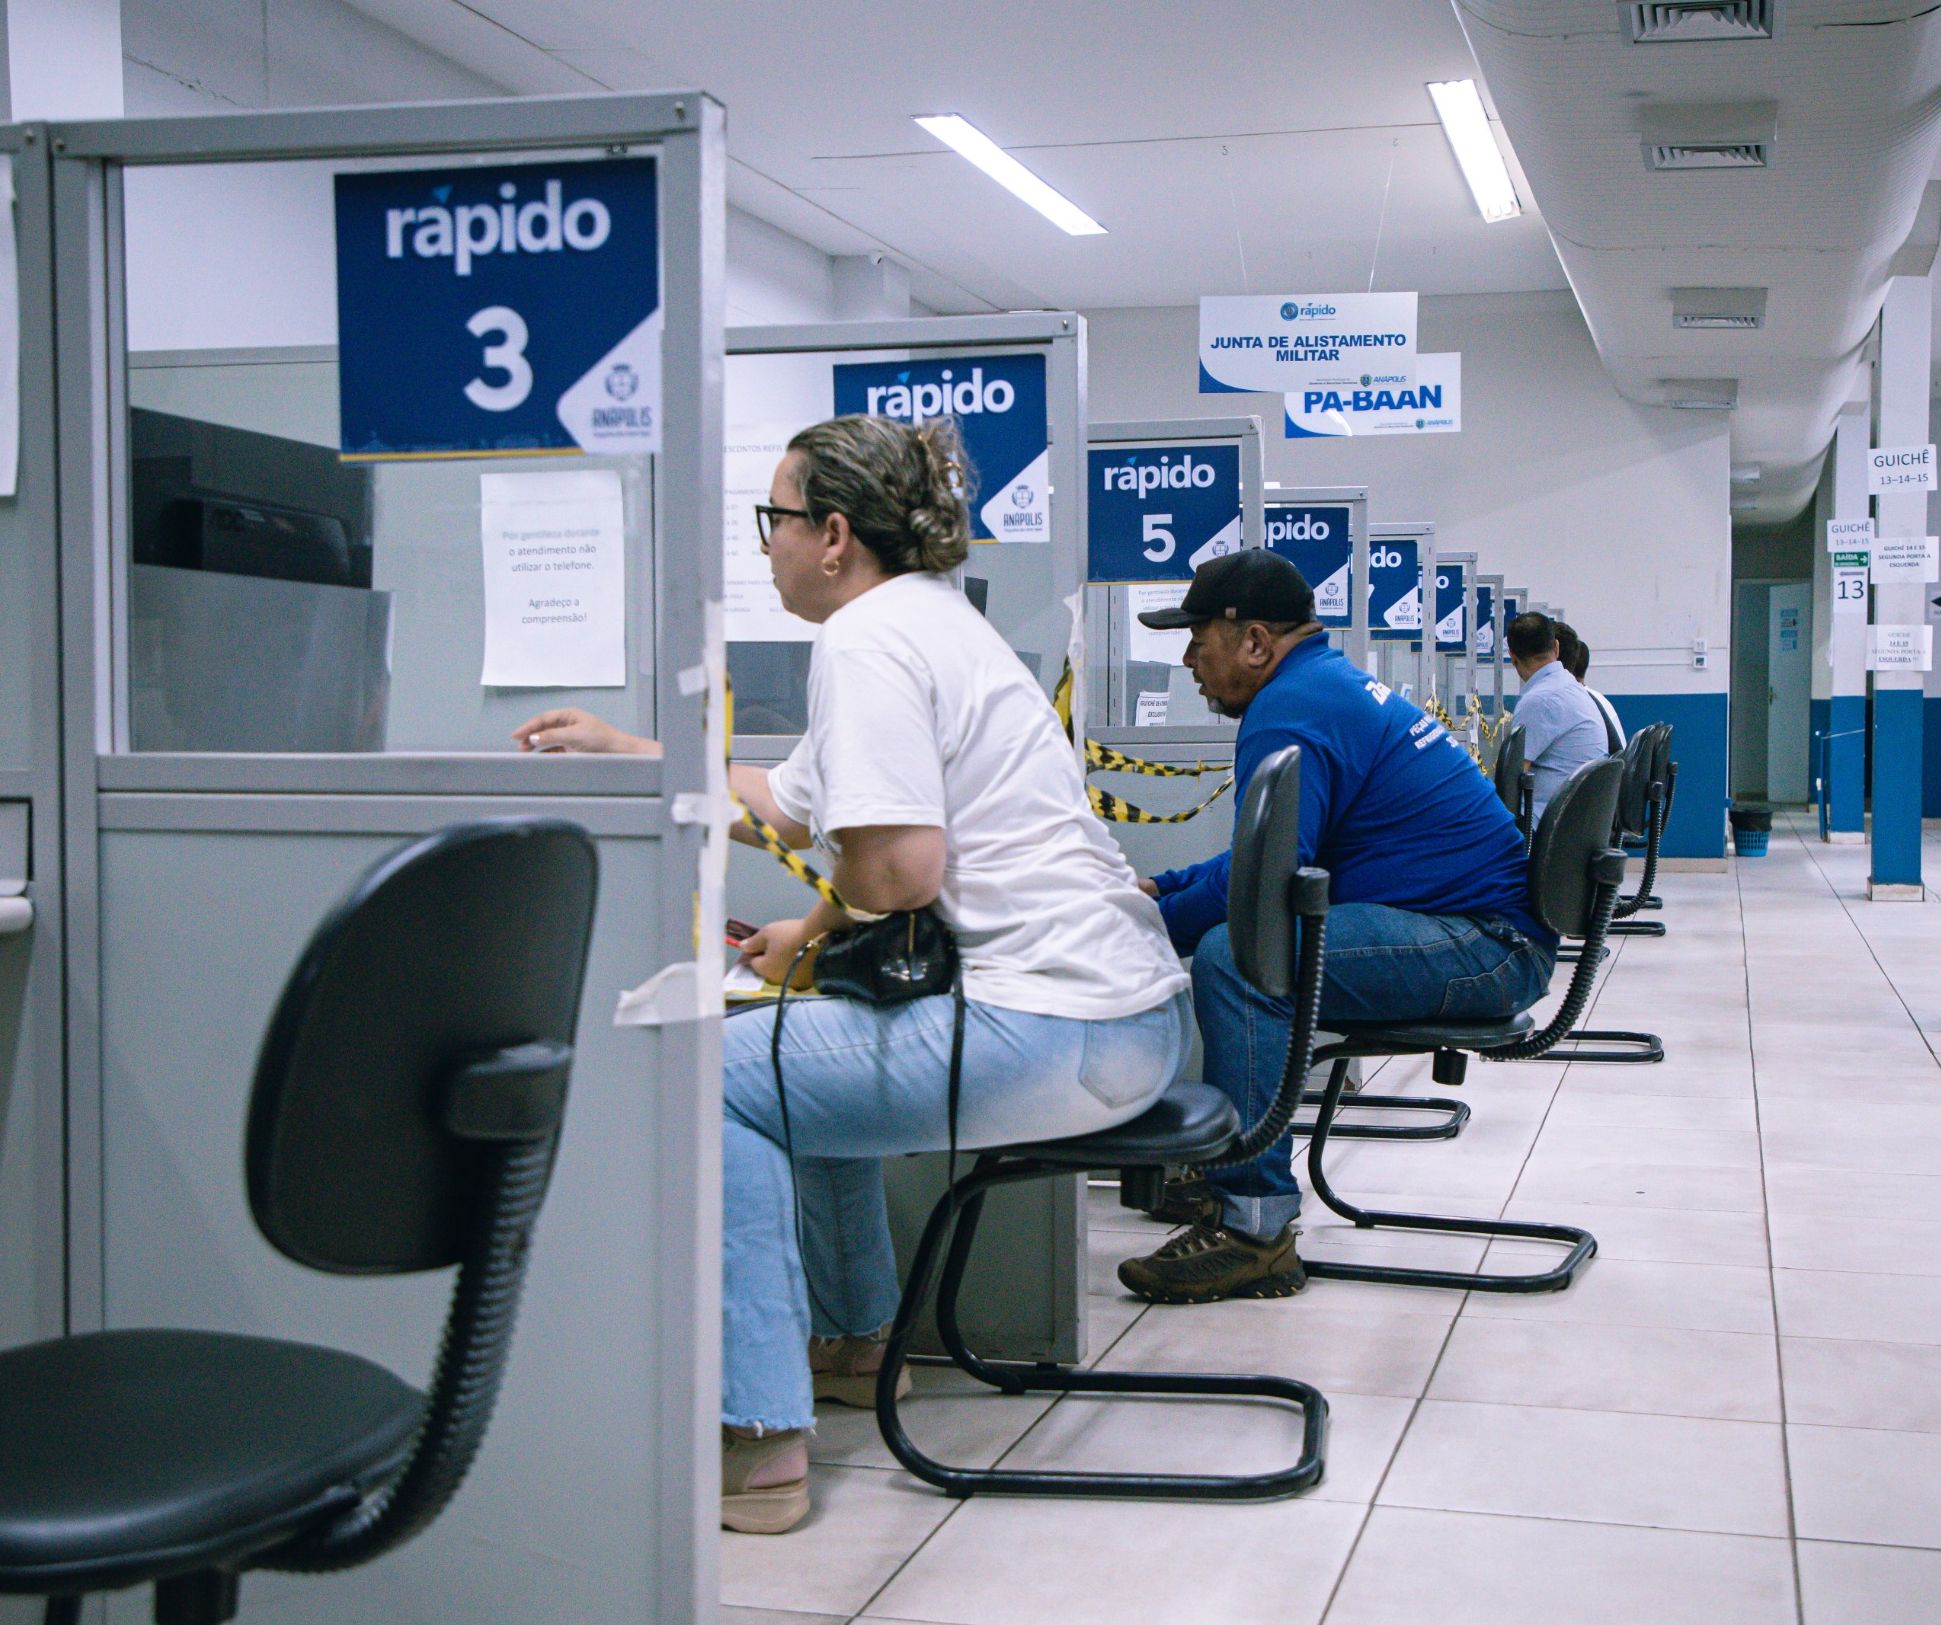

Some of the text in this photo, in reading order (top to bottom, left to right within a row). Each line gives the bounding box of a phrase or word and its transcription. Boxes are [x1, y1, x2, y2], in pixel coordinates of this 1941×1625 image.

[386, 179, 612, 276] rápido
[1300, 302, 1336, 318] rápido
[1211, 334, 1407, 349] JUNTA DE ALISTAMENTO
[463, 305, 534, 412] 3
[1276, 349, 1340, 362] MILITAR
[867, 368, 1015, 427] rápido
[1304, 385, 1442, 414] PA-BAAN
[1874, 449, 1929, 468] GUICHÊ
[1104, 455, 1216, 499] rápido
[1831, 522, 1871, 534] GUICHÊ
[1142, 513, 1176, 563] 5
[509, 543, 597, 556] o atendimento não
[512, 562, 542, 572] utilizar
[544, 563, 551, 571] o
[1837, 580, 1865, 600] 13
[529, 598, 580, 609] Agradeço a
[522, 613, 587, 625] compreensão!
